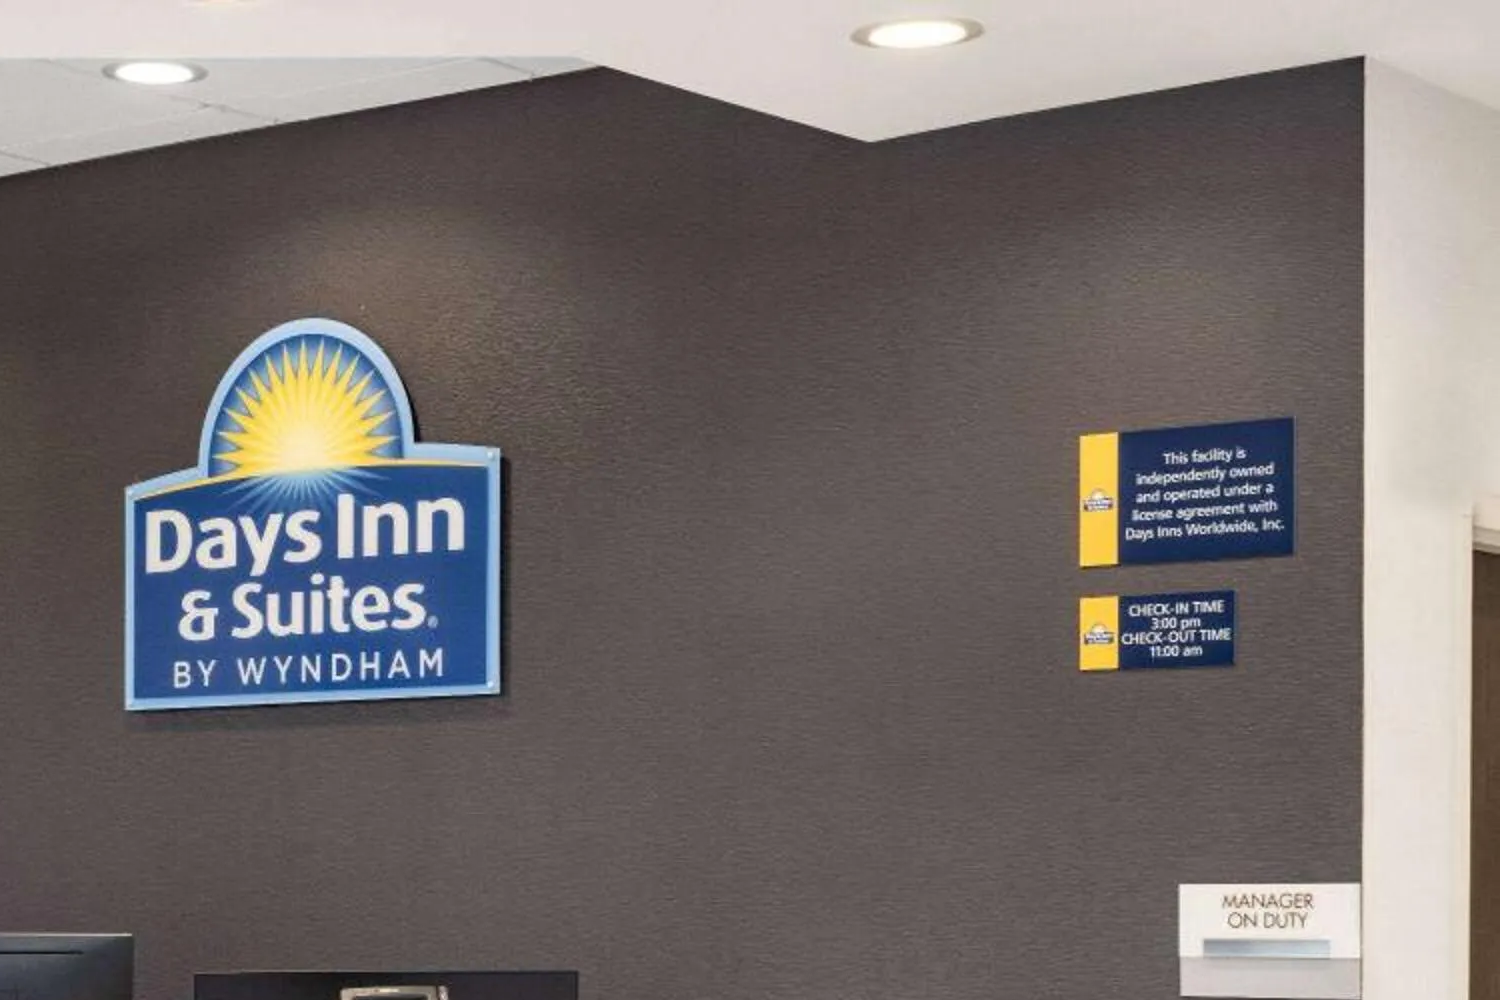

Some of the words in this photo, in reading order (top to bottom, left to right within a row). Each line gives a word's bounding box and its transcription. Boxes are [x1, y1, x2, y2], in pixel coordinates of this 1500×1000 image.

[1162, 451, 1189, 465] This
[1191, 448, 1233, 463] facility
[1236, 446, 1247, 459] is
[1135, 466, 1227, 486] independently
[1229, 461, 1276, 478] owned
[1135, 489, 1161, 503] and
[1163, 485, 1221, 504] operated
[1223, 483, 1262, 497] under
[1265, 484, 1275, 494] a
[1131, 508, 1173, 521] license
[1175, 503, 1245, 521] agreement
[1247, 499, 1278, 514] with
[145, 508, 322, 577] Days
[337, 493, 465, 560] Inn
[1125, 527, 1154, 542] Days
[1157, 525, 1184, 539] Inns
[1261, 517, 1285, 531] Inc.
[177, 589, 218, 642] &
[231, 573, 426, 640] Suites
[1128, 601, 1189, 617] CHECK-IN
[1192, 599, 1225, 614] TIME
[1150, 617, 1177, 630] 3:00
[1180, 617, 1201, 630] pm
[1121, 629, 1197, 645] CHECK-OUT
[1199, 628, 1232, 641] TIME
[1149, 645, 1180, 657] 11:00
[1182, 645, 1203, 657] am
[173, 659, 217, 689] BY
[237, 647, 444, 686] WYNDHAM
[1222, 893, 1314, 909] MANAGER
[1227, 911, 1258, 929] ON
[1263, 911, 1309, 929] DUTY
